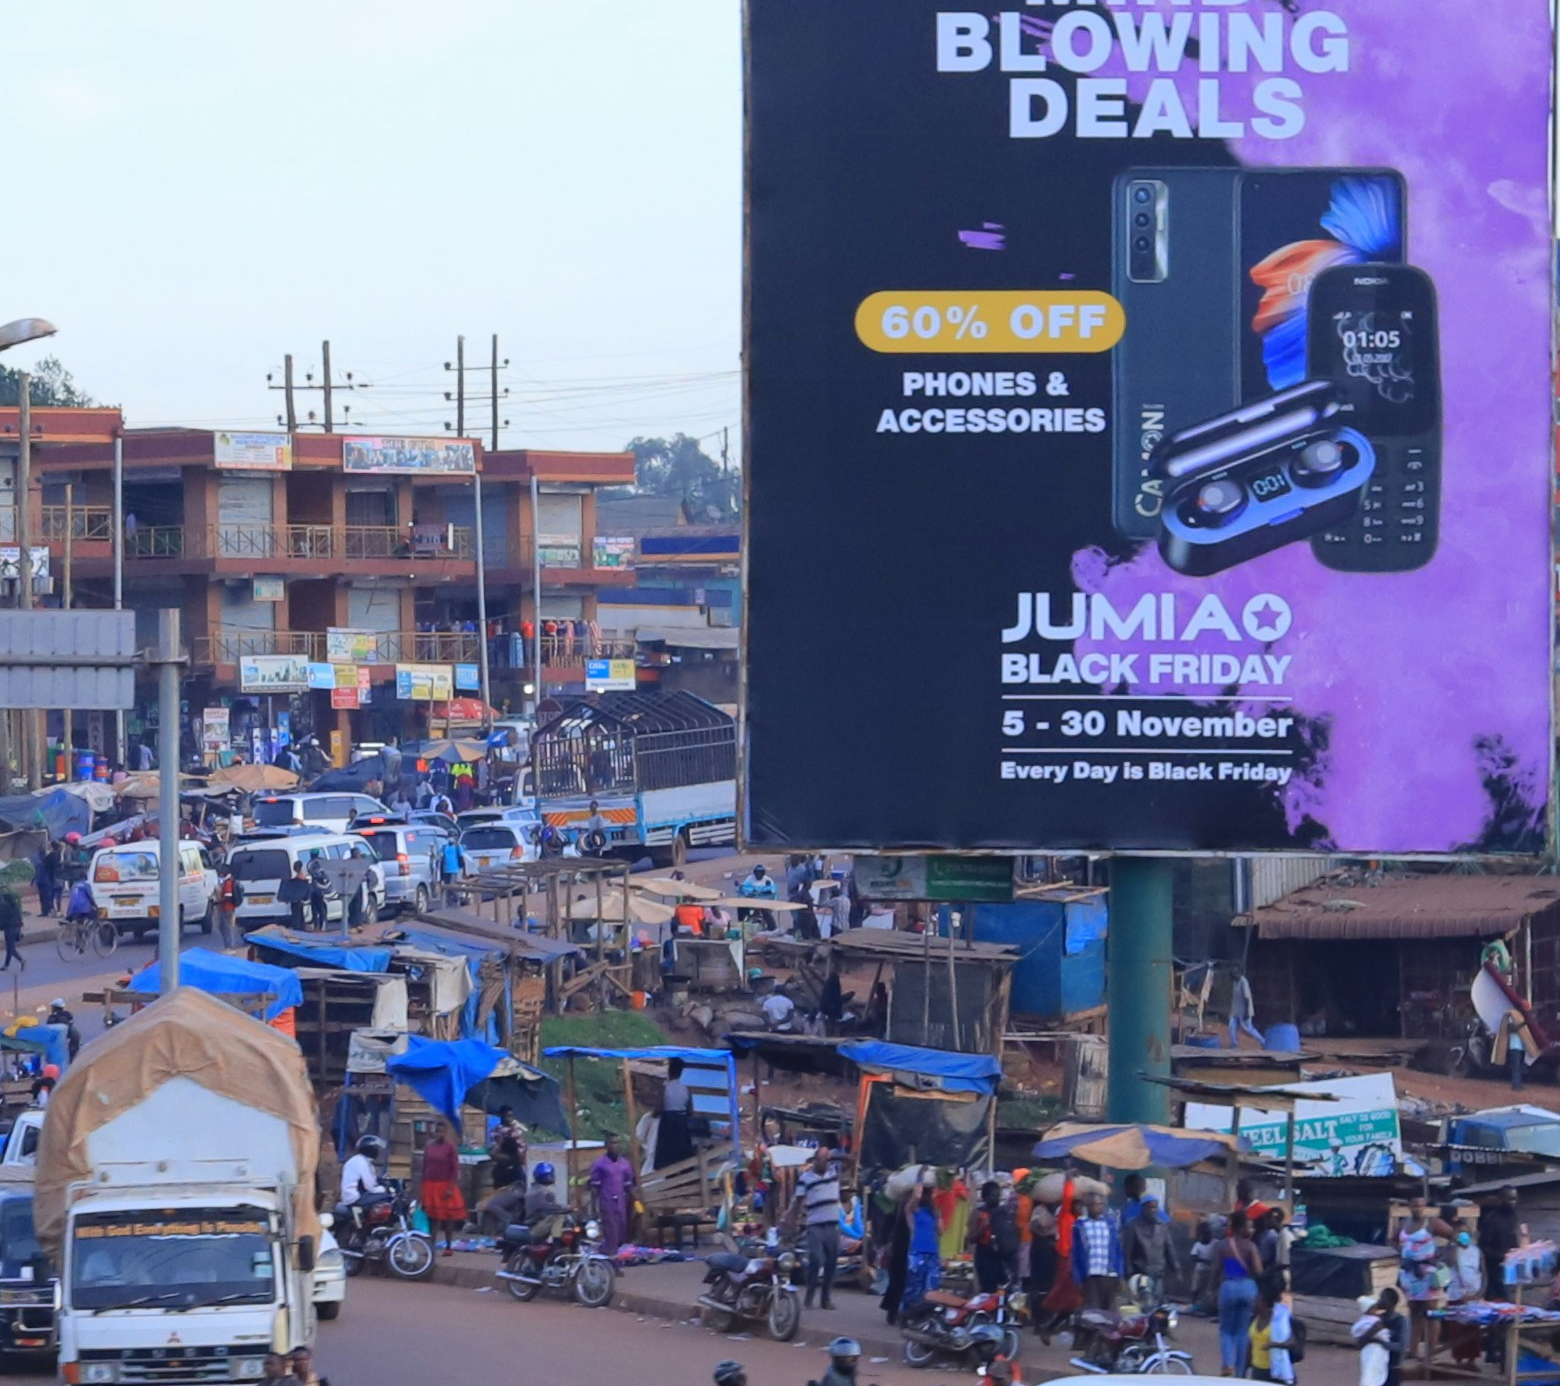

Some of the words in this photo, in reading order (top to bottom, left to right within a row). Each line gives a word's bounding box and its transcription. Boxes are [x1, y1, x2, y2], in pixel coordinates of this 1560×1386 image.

[936, 10, 1350, 74] BLOWING
[1009, 77, 1305, 140] DEALS
[881, 304, 988, 340] 60%
[1009, 304, 1106, 339] OFF
[1343, 330, 1401, 348] 01:05
[903, 372, 1037, 396] PHONES
[1046, 372, 1070, 396] &
[876, 408, 1106, 433] ACCESSORIES
[1001, 653, 1140, 684] BLACK
[1149, 654, 1293, 685] FRIDAY
[1001, 710, 1025, 736] 5
[1060, 710, 1106, 736] 30
[1116, 710, 1294, 737] November
[1001, 761, 1069, 783] Every
[1073, 761, 1118, 783] Day
[1123, 760, 1144, 780] is
[1148, 762, 1213, 781] Black
[1218, 762, 1293, 785] Friday
[1292, 1120, 1339, 1141] SALT
[1359, 1124, 1374, 1132] FOR
